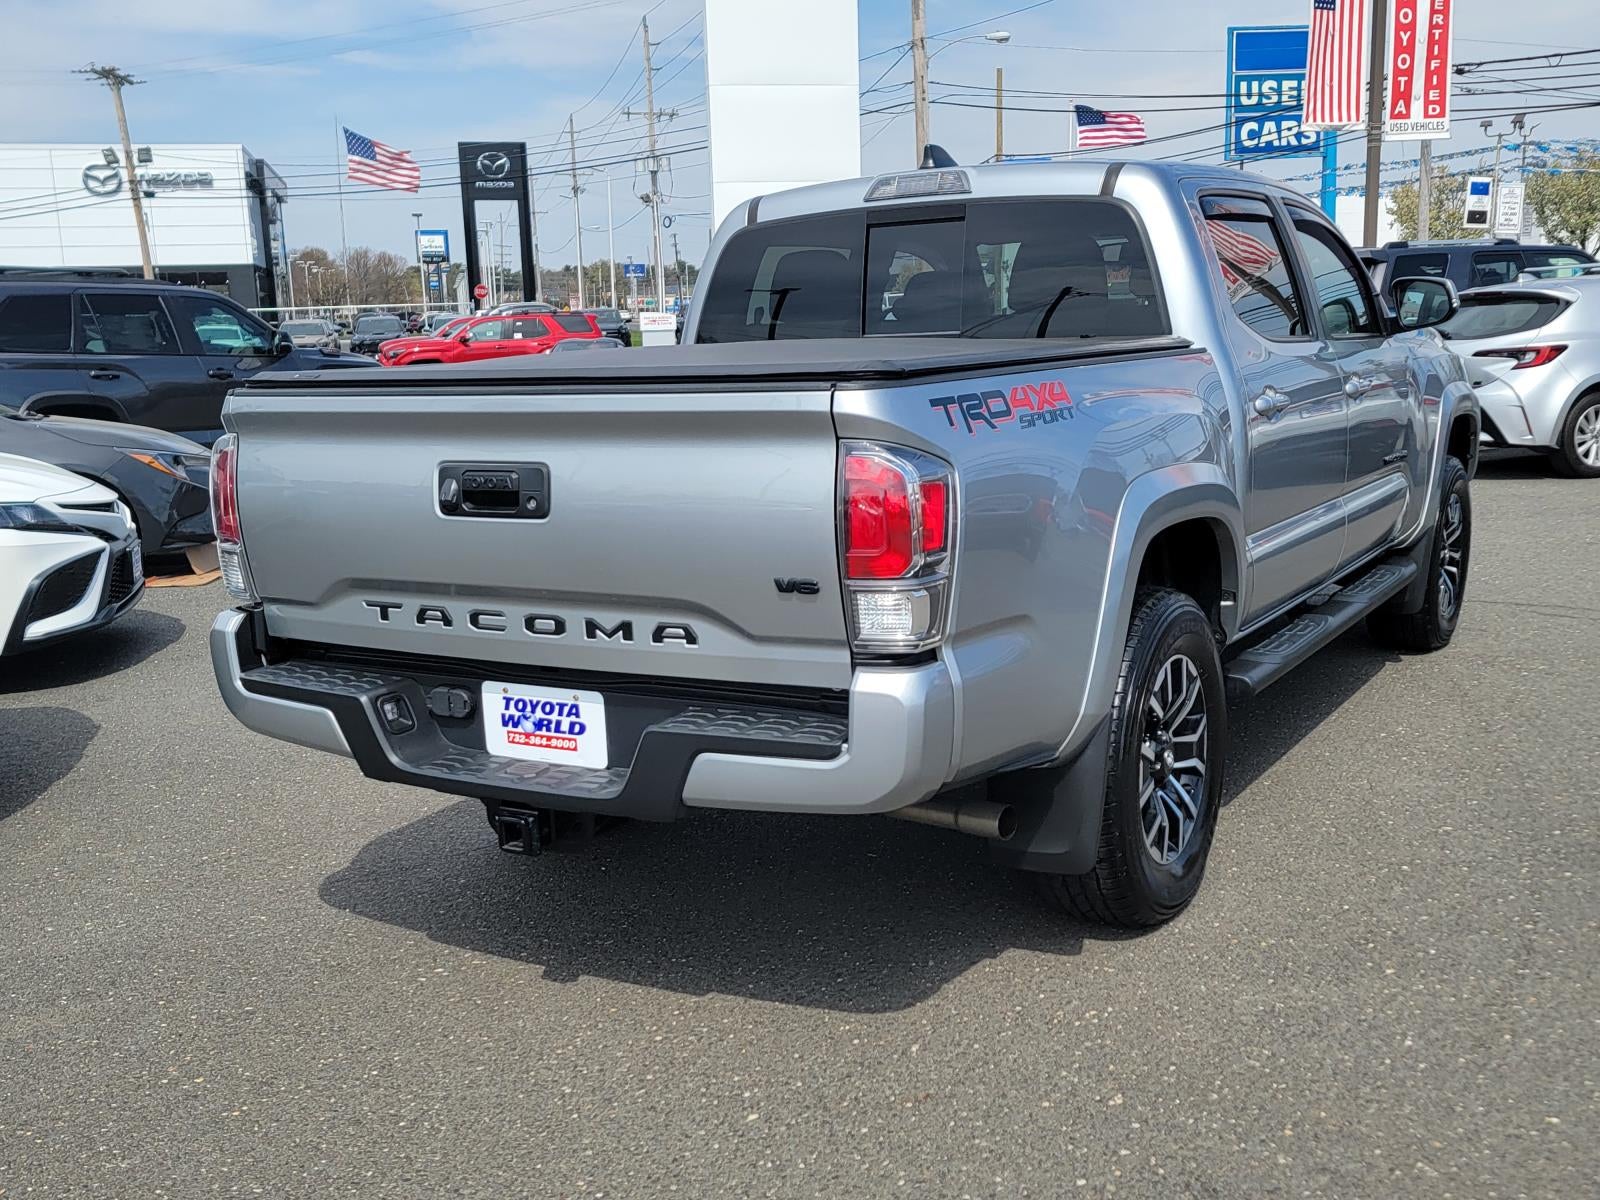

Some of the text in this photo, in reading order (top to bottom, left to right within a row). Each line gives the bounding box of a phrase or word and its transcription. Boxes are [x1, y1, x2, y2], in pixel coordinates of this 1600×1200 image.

[1394, 0, 1412, 115] OYOTA
[1240, 120, 1317, 148] CARS
[1390, 121, 1445, 132] USED VEHICLES
[475, 181, 515, 189] mazda
[474, 287, 488, 295] STOP
[929, 389, 1015, 437] TRD
[1019, 406, 1074, 429] SPORT
[464, 475, 513, 489] TOYOTA
[773, 578, 820, 595] V6
[361, 600, 699, 648] TACOMA
[502, 696, 581, 719] TOYOTA
[501, 713, 587, 736] WORLD
[508, 732, 577, 750] 732-364-9000
